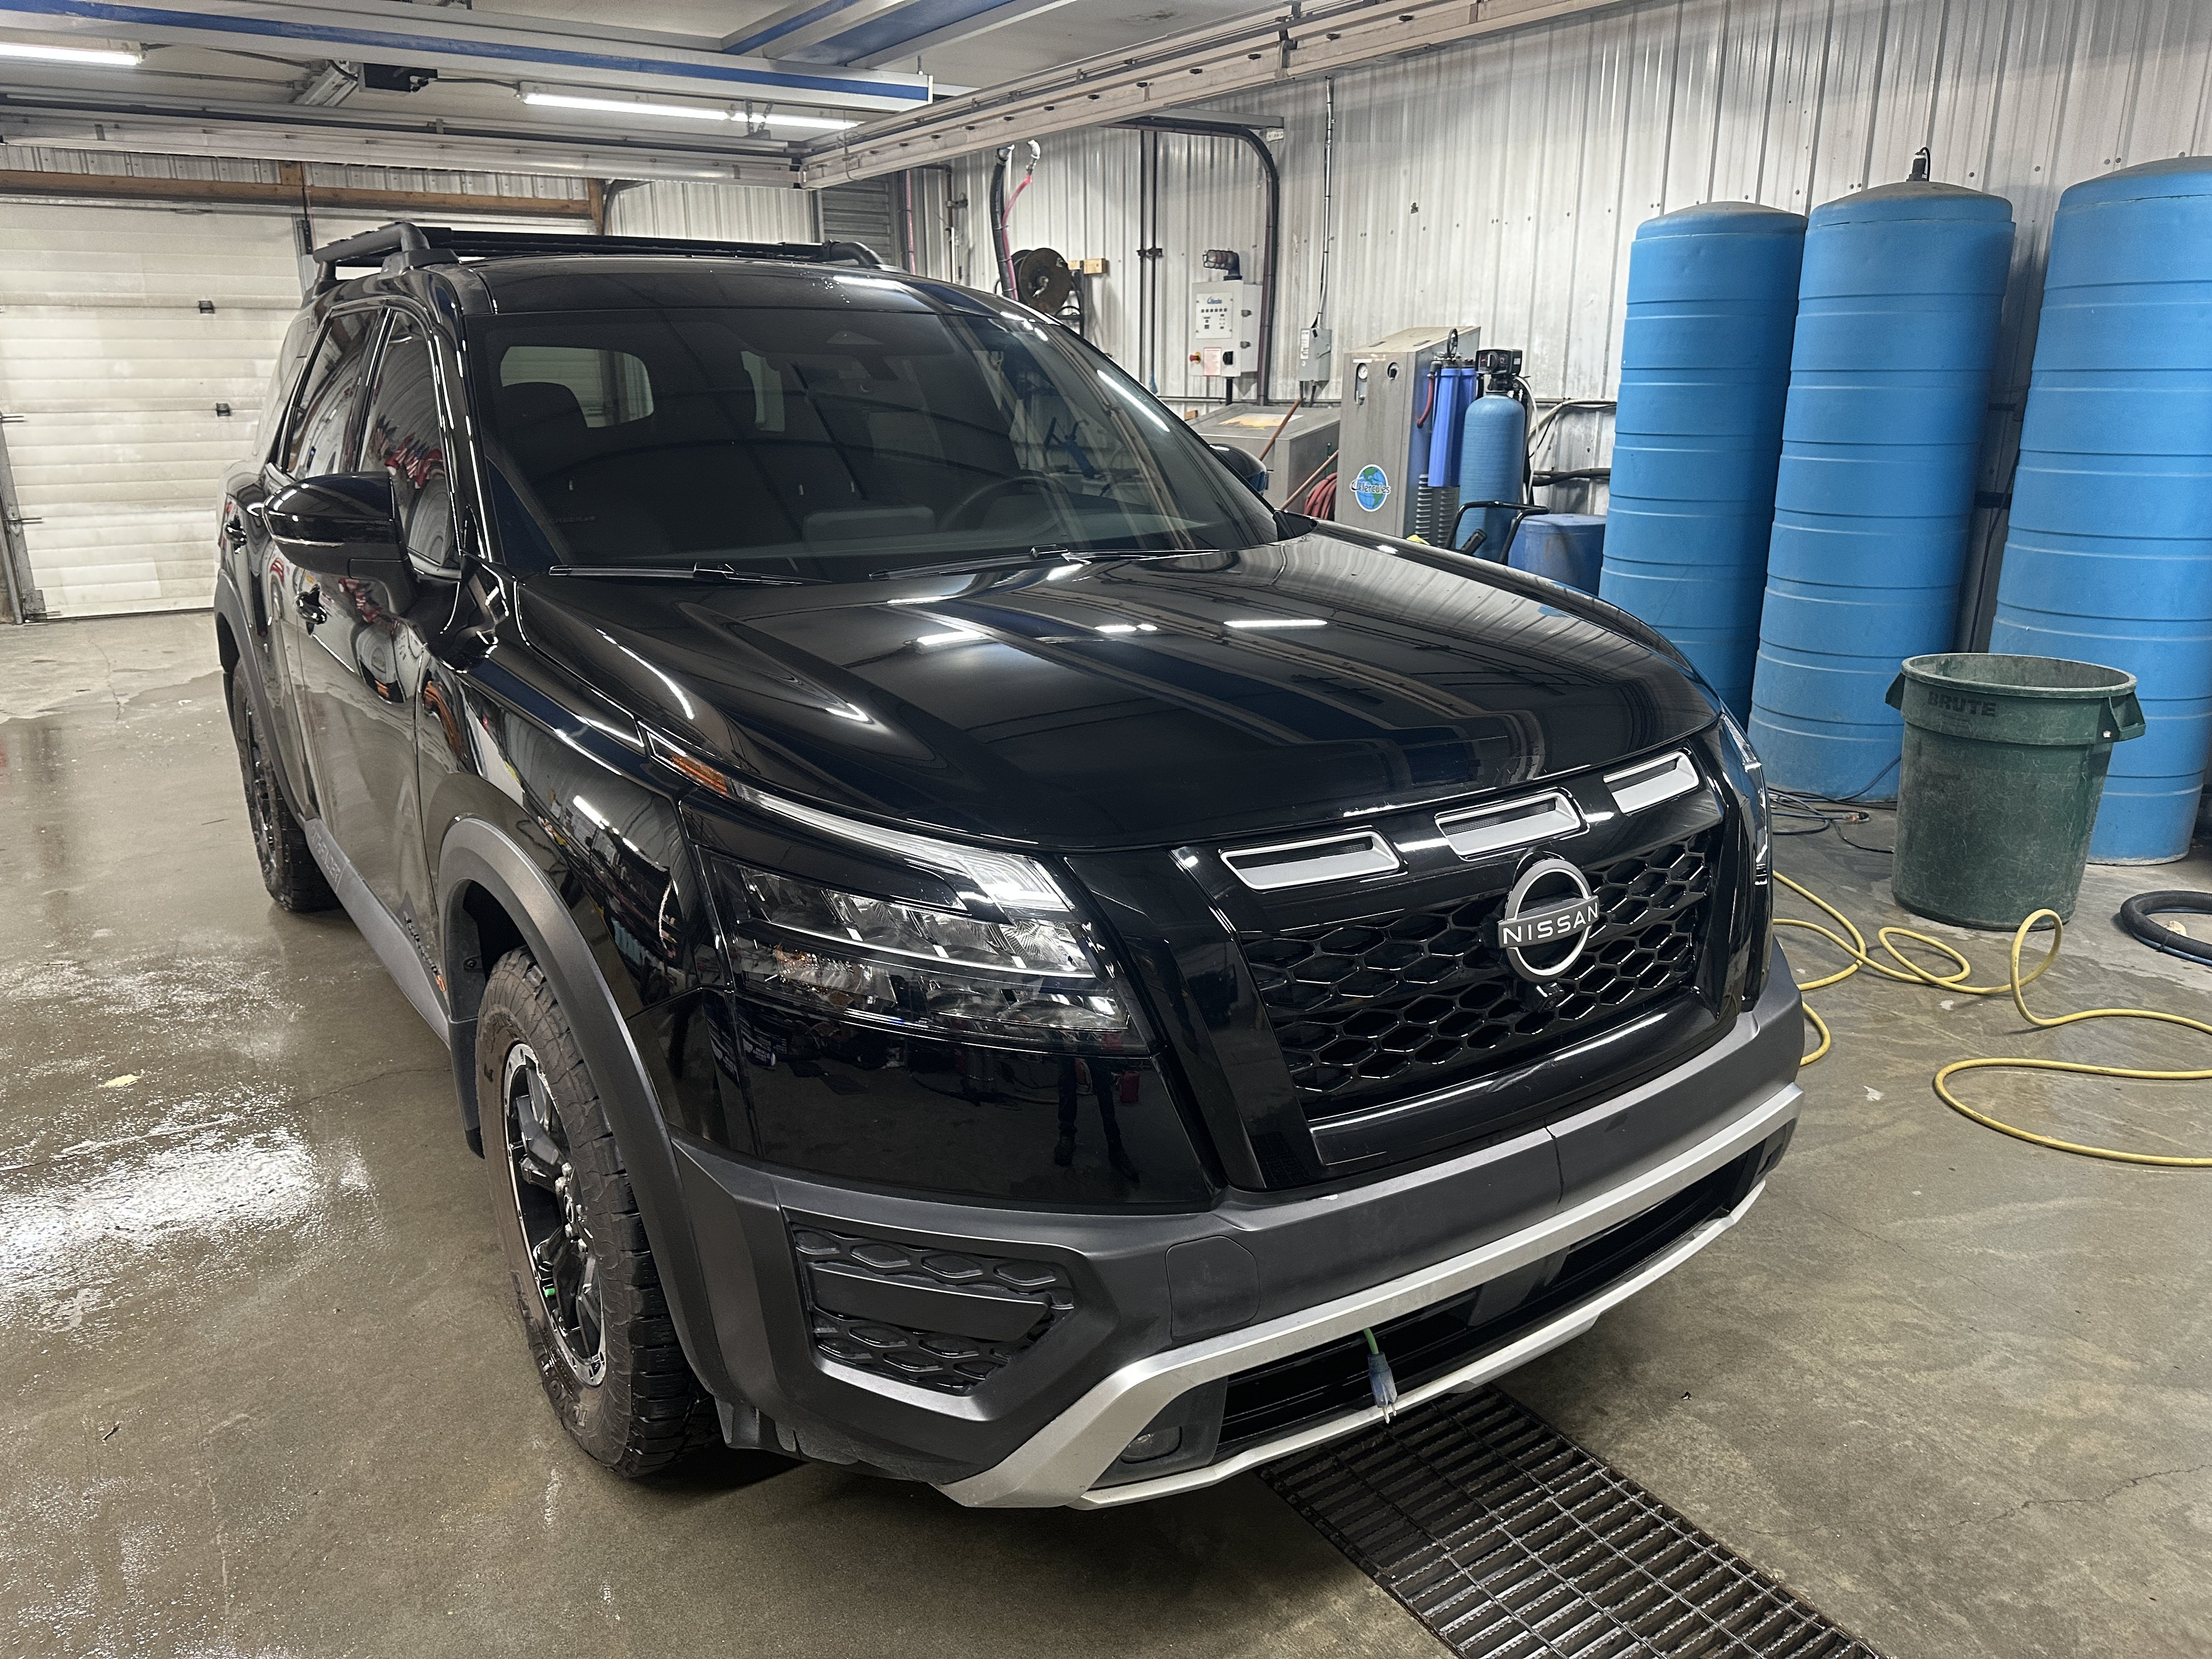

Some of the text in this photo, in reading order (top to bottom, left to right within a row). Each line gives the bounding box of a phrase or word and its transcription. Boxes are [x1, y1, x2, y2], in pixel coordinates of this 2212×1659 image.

[1353, 479, 1391, 494] Hercules
[1927, 691, 1997, 718] BRUTE
[1503, 901, 1598, 944] NISSAN
[549, 1377, 588, 1429] TOYO
